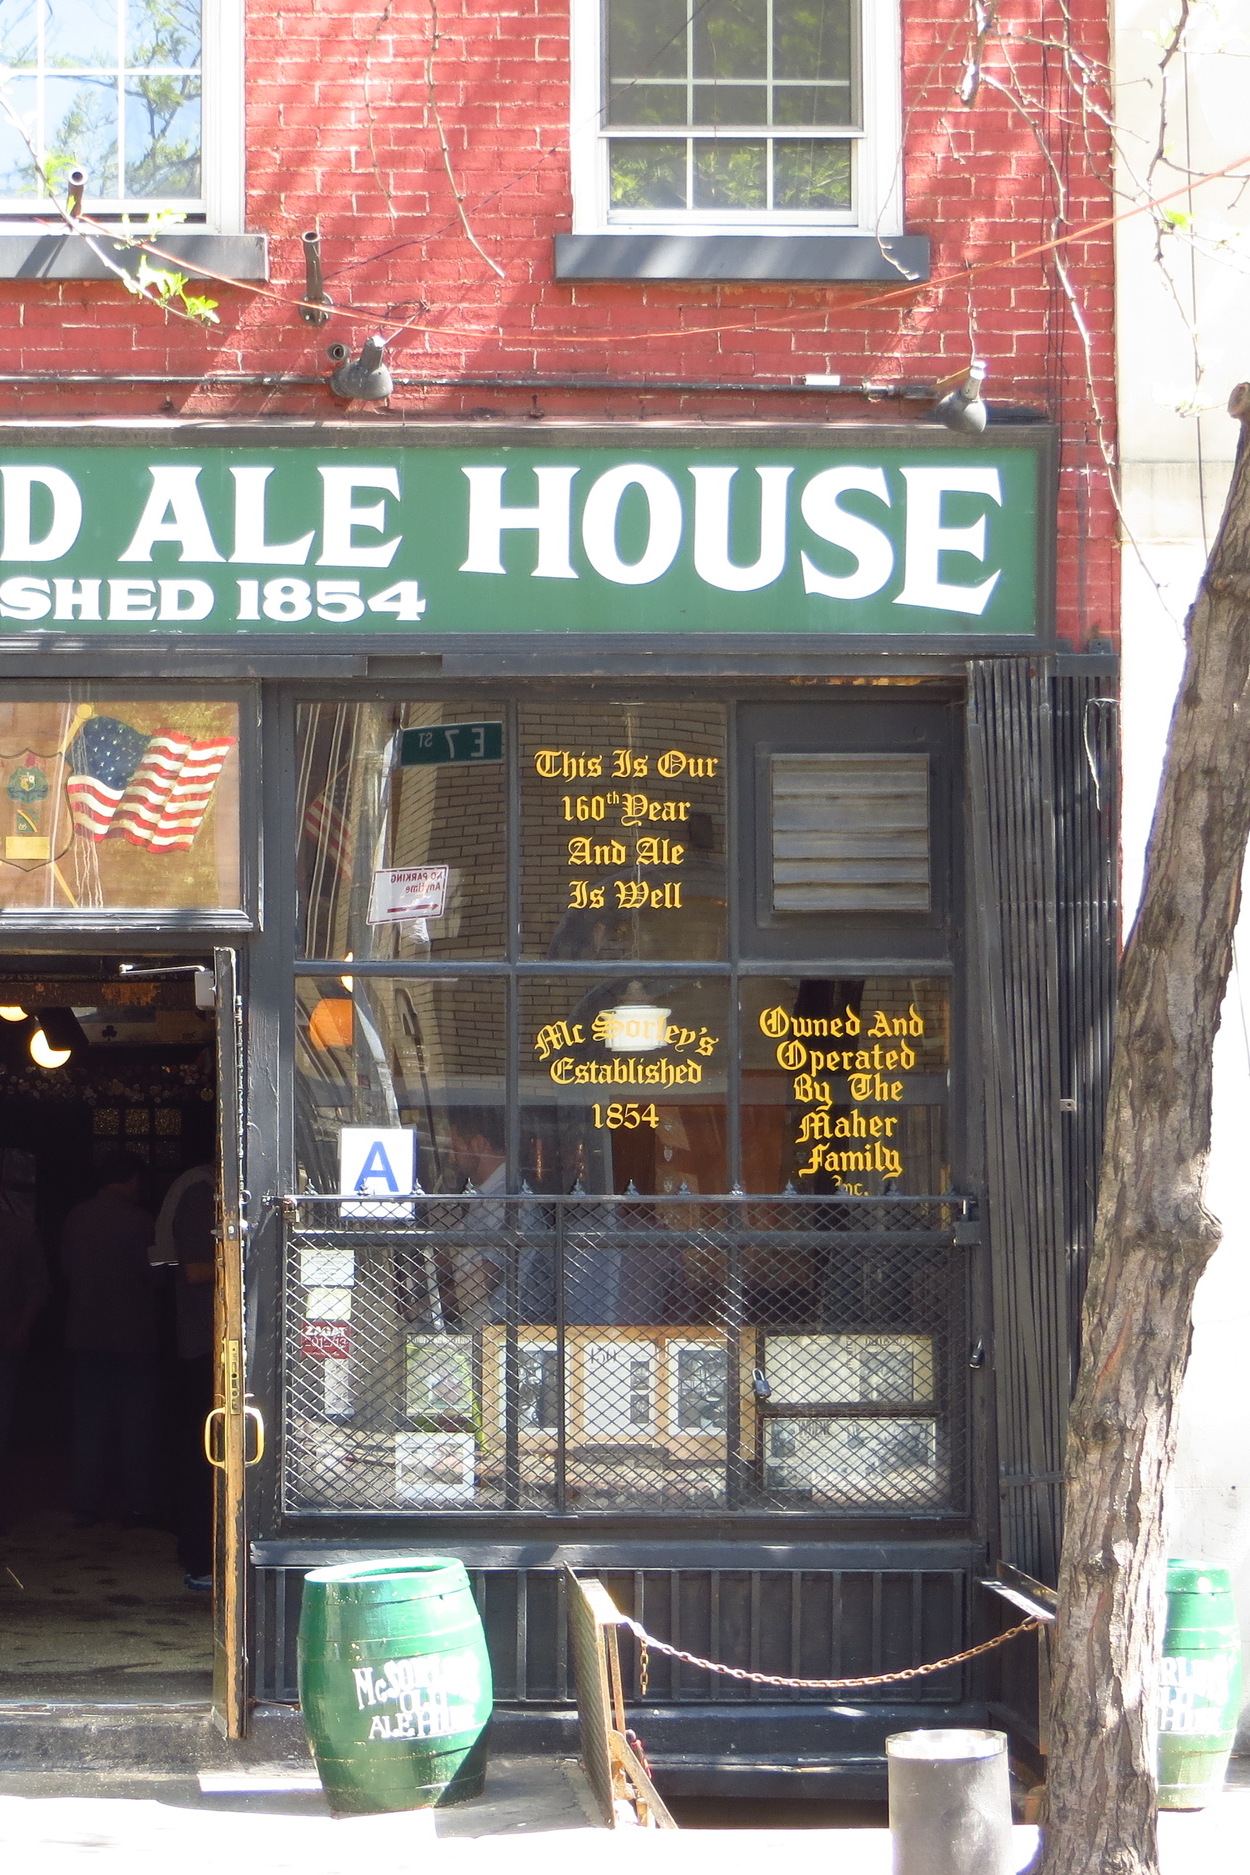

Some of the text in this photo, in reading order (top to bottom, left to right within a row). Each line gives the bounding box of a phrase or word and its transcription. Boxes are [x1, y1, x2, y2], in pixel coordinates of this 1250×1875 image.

[116, 466, 404, 569] ALE
[458, 463, 1004, 616] HOUSE
[235, 577, 427, 623] 1854
[533, 749, 720, 783] This Is Our
[560, 790, 692, 827] 160th Year
[567, 836, 686, 866] And Ale
[567, 880, 684, 910] Is Well
[534, 1012, 720, 1062] Mc Sorley's
[759, 1003, 925, 1038] Owned And
[549, 1056, 703, 1090] Established
[776, 1038, 917, 1078] Operated
[793, 1072, 905, 1112] By The
[591, 1103, 661, 1130] 1854
[794, 1108, 899, 1144] Maher
[353, 1141, 400, 1192] A
[797, 1140, 904, 1182] Family
[368, 1714, 416, 1740] ALE
